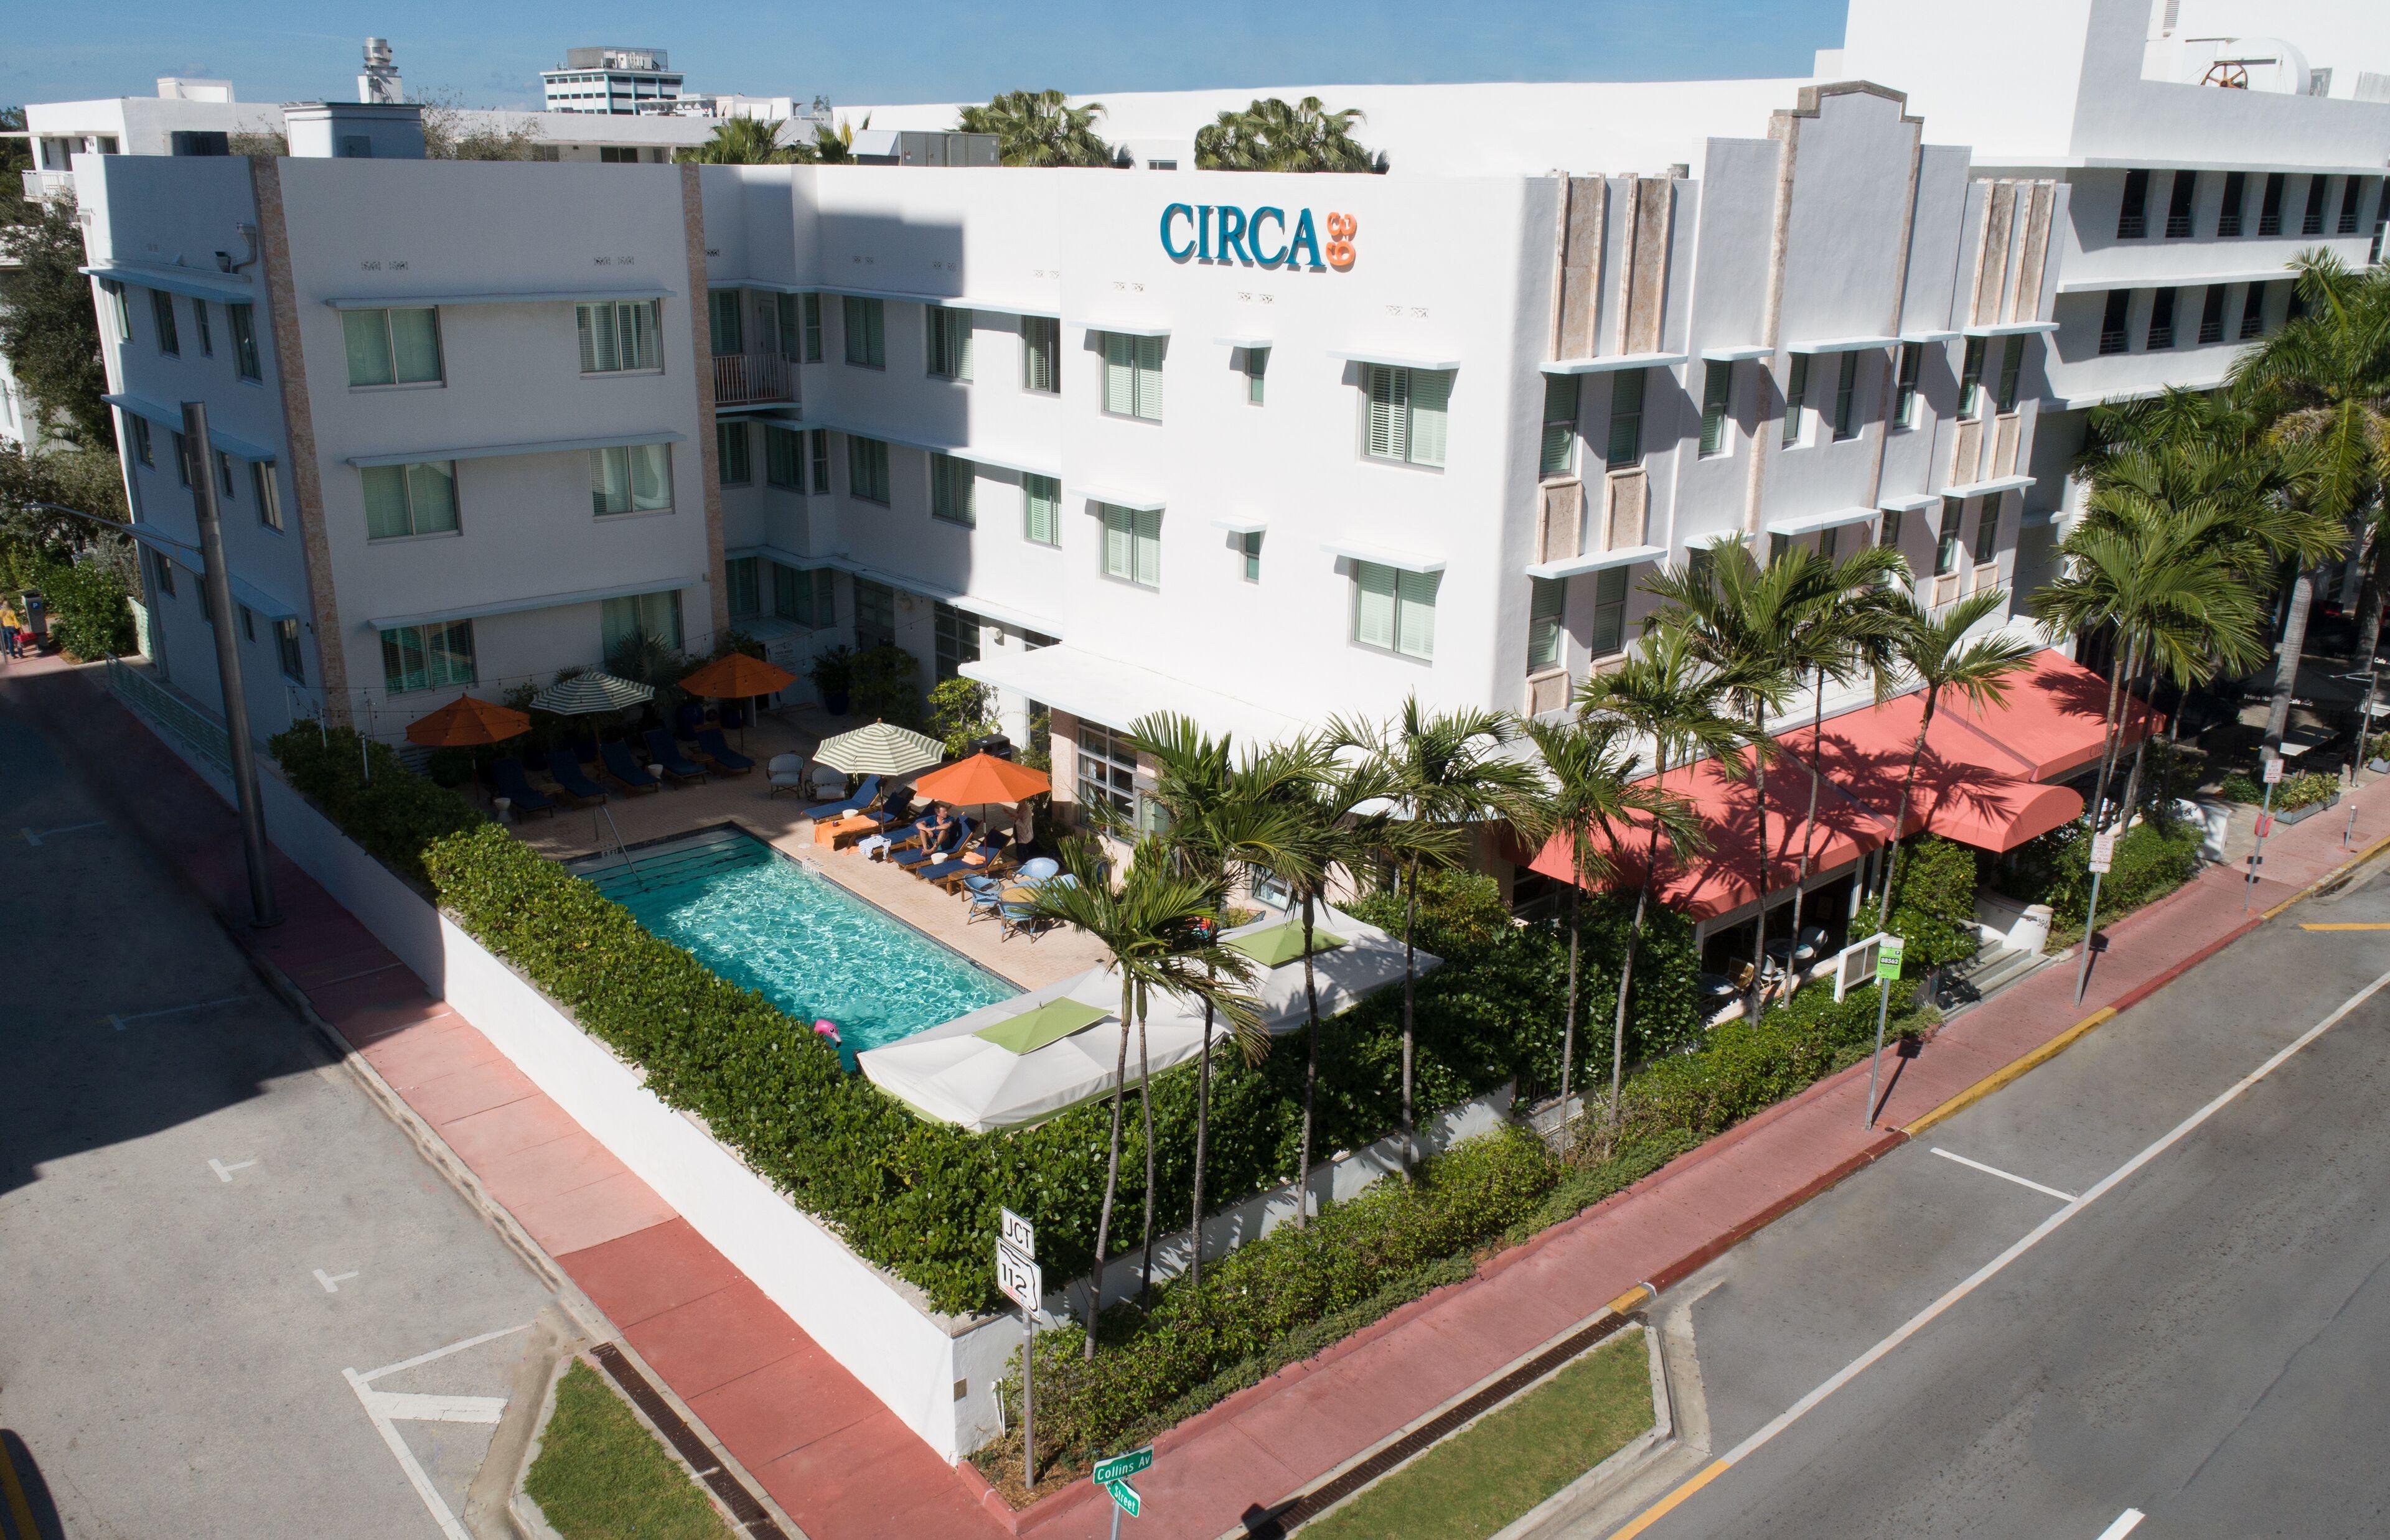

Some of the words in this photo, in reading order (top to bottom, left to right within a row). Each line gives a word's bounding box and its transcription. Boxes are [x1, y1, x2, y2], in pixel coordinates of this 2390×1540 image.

[1160, 202, 1326, 266] CIRCA
[1325, 212, 1357, 266] 39
[1006, 1218, 1031, 1249] JCT
[1002, 1263, 1027, 1298] 112
[1097, 1462, 1134, 1481] Collins
[1138, 1455, 1151, 1468] Av
[1113, 1485, 1136, 1513] Street
